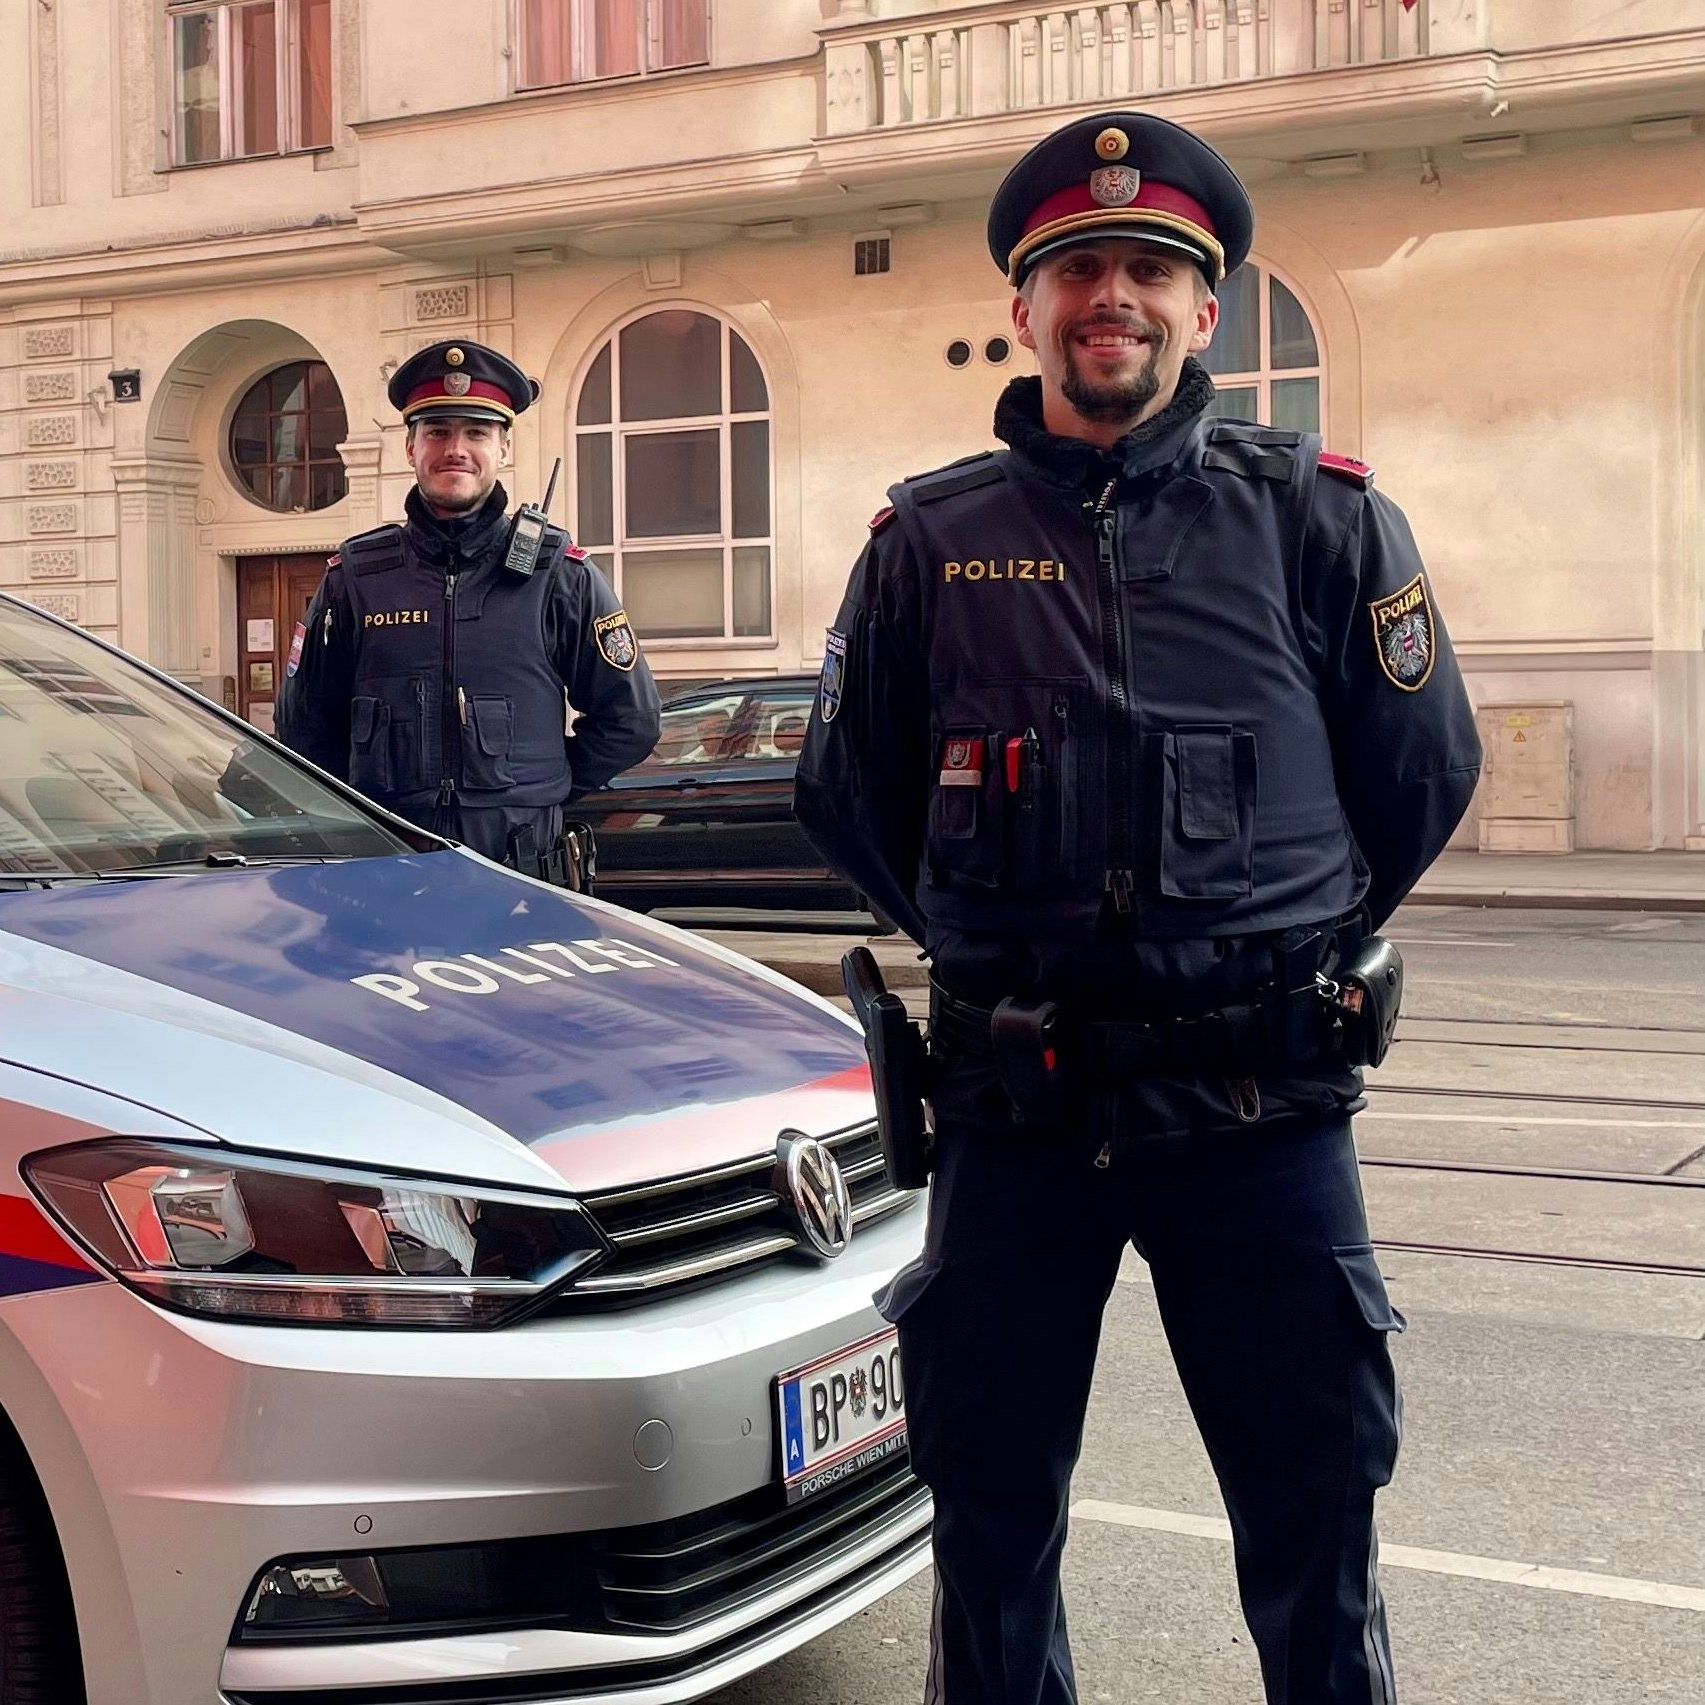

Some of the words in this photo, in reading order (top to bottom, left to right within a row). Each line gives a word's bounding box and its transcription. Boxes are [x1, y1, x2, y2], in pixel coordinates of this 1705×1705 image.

[121, 381, 133, 397] 3
[944, 559, 1065, 583] POLIZEI
[364, 610, 429, 628] POLIZEI
[350, 938, 681, 1012] POLIZEI
[790, 1438, 800, 1461] A
[801, 1459, 855, 1497] PORSCHE
[856, 1441, 885, 1469] WIEN
